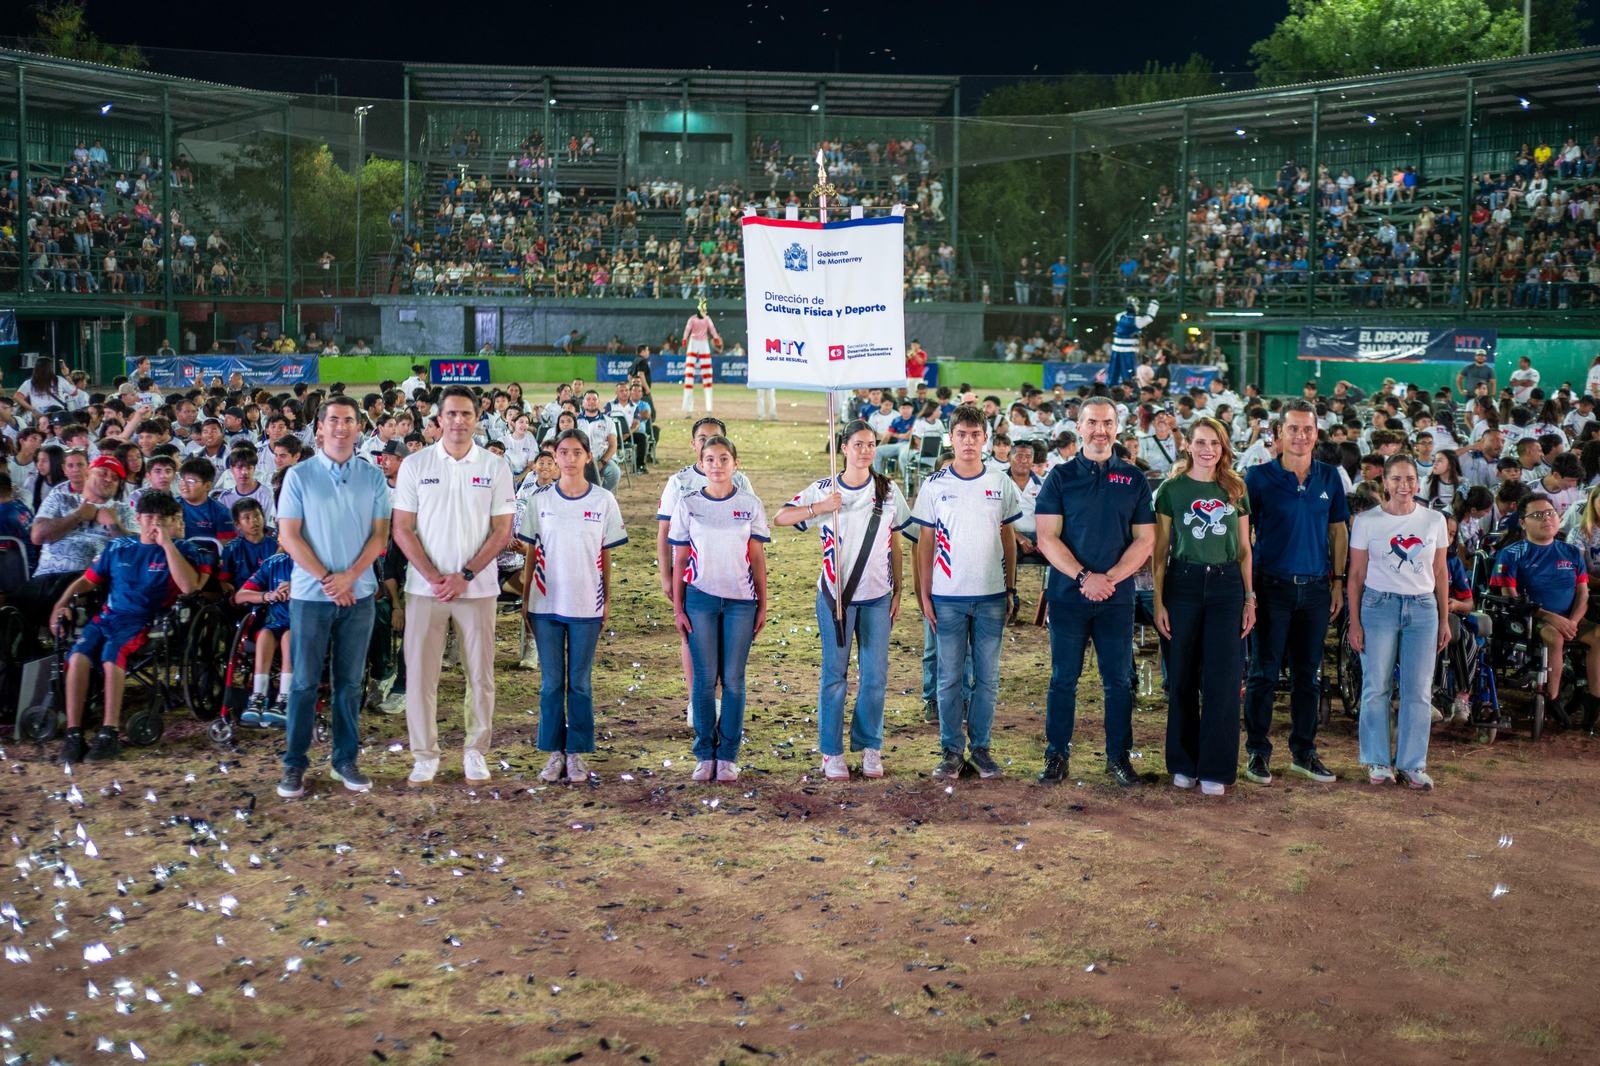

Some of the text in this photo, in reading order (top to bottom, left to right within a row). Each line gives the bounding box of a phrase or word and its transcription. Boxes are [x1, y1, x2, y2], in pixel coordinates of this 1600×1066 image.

[765, 291, 825, 305] Dirección de
[765, 303, 886, 318] Cultura Física y Deporte
[1359, 331, 1430, 343] EL DEPORTE
[1455, 335, 1484, 348] MTY
[766, 338, 805, 356] MTY
[440, 362, 480, 377] MTY
[1107, 473, 1132, 485] MTY
